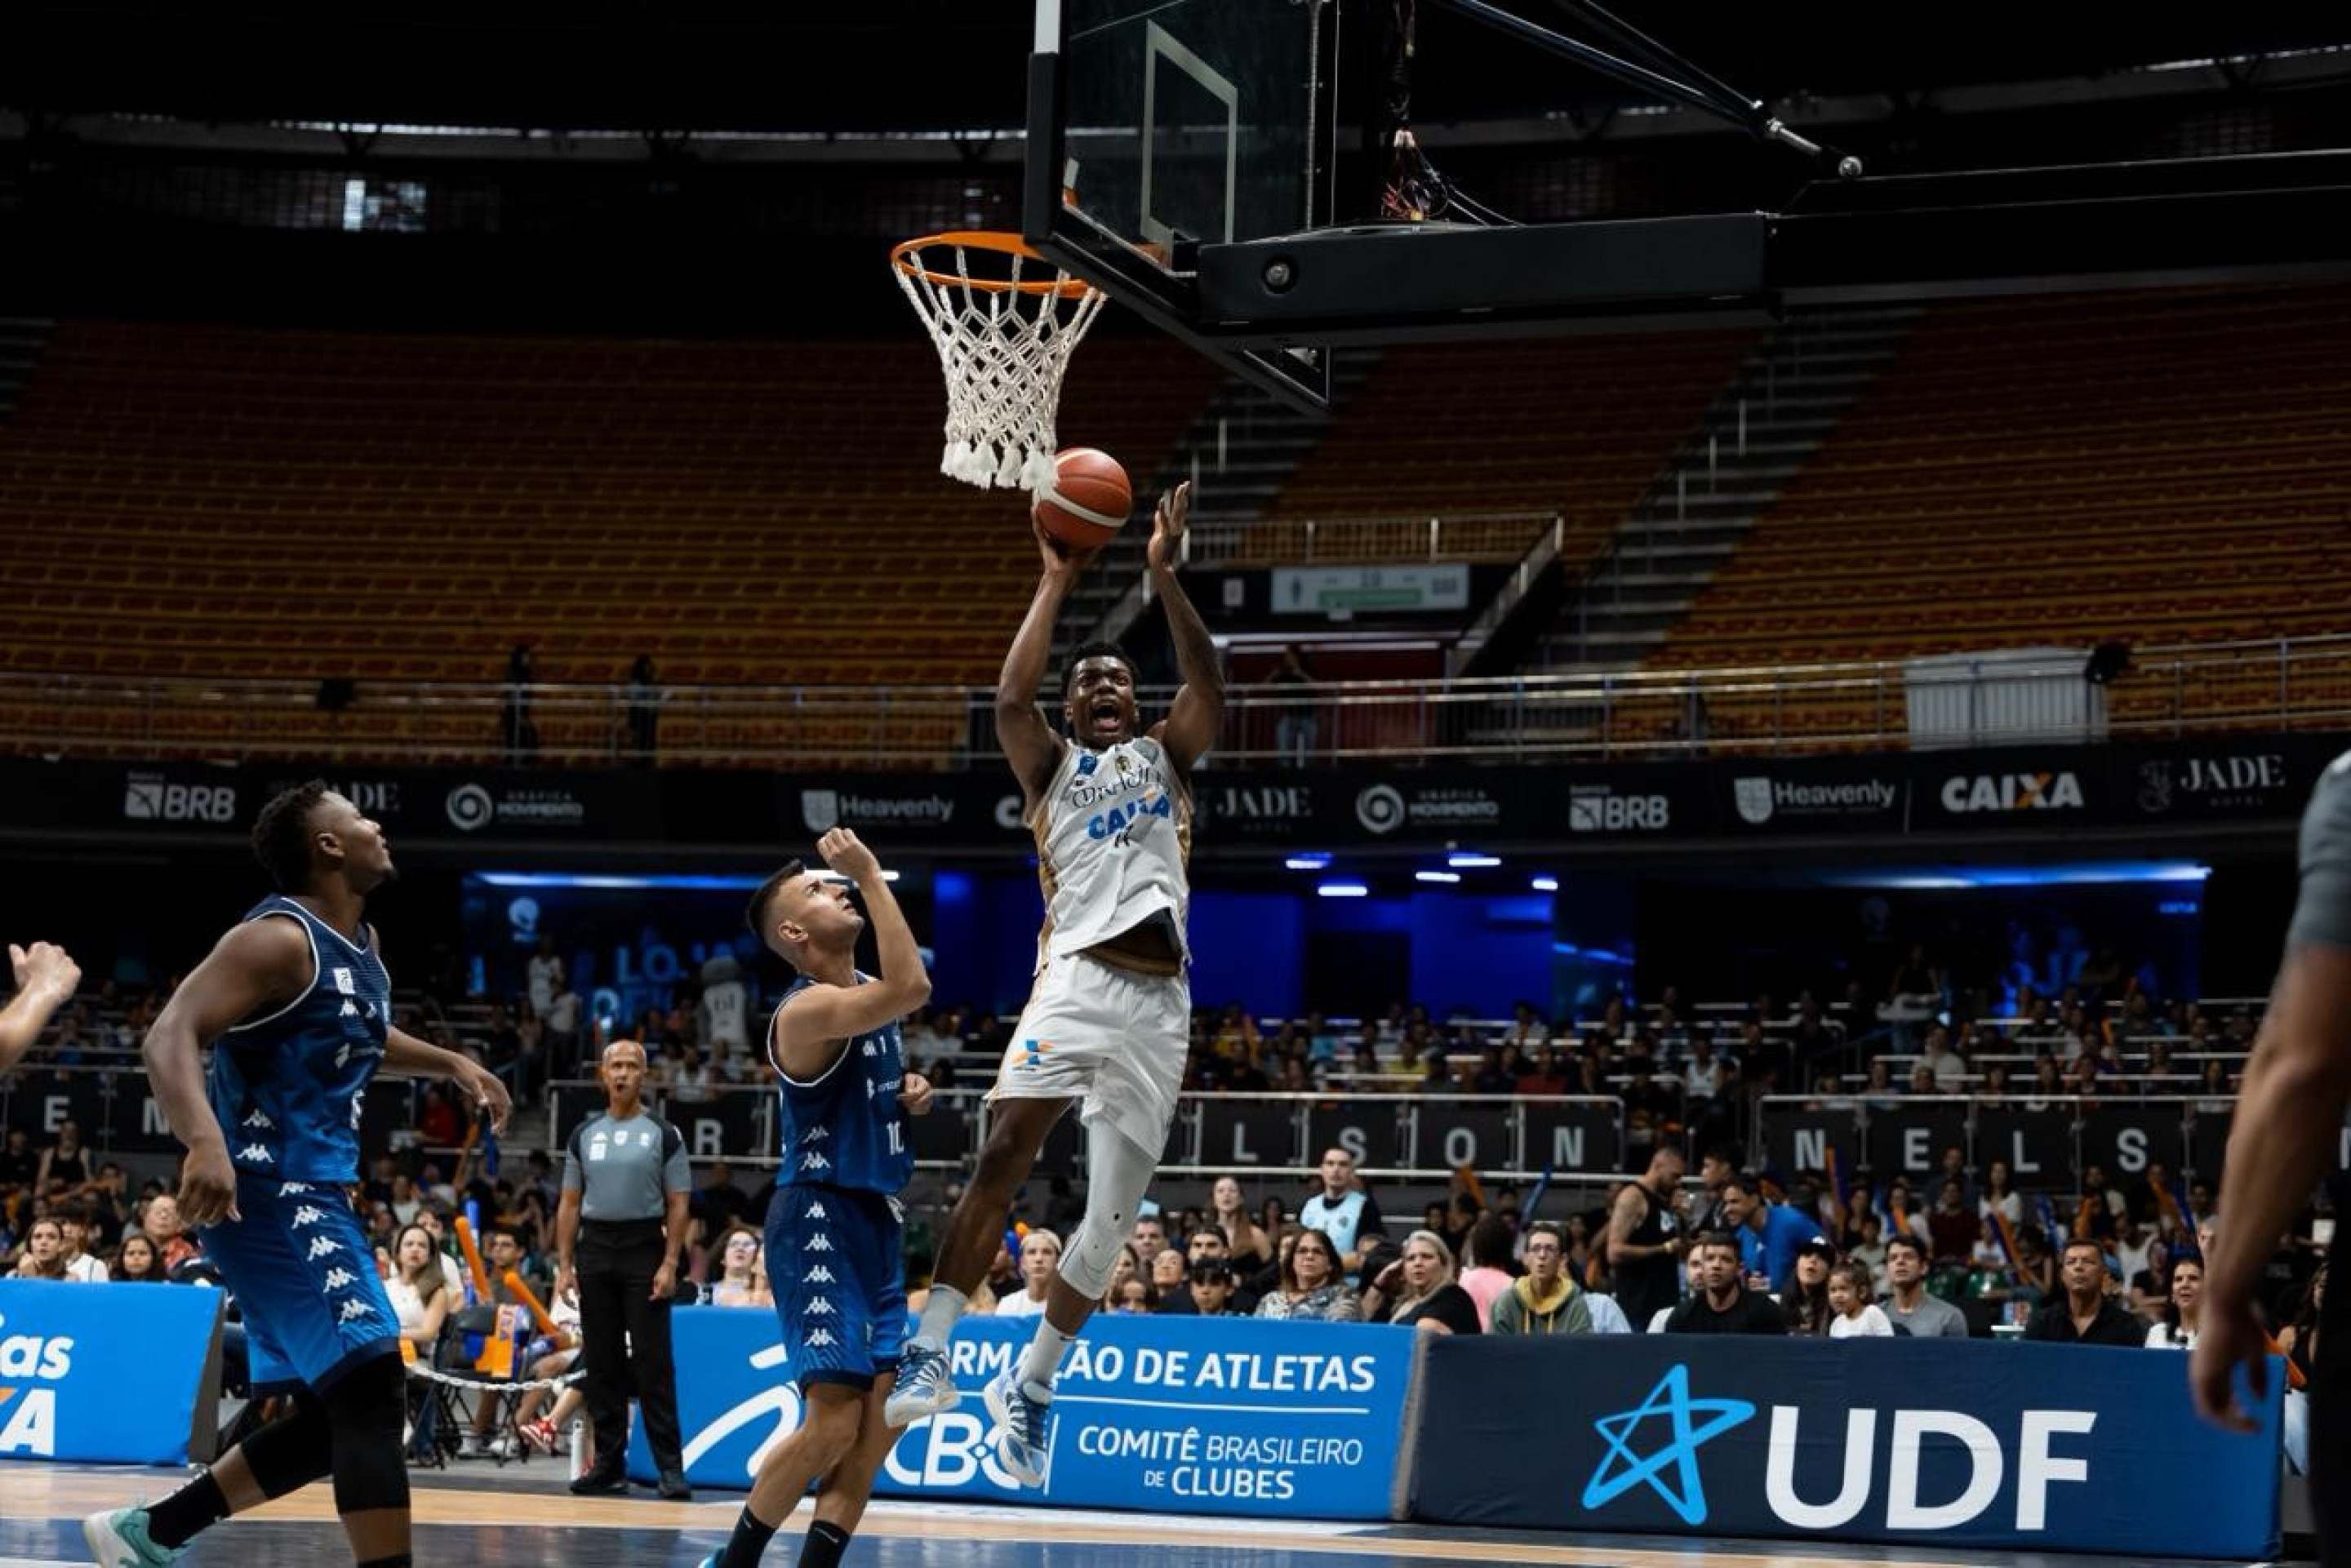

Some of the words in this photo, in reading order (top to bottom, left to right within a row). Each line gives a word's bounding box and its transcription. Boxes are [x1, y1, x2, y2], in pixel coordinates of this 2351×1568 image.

[2180, 754, 2287, 792] JADE
[163, 784, 235, 821] BRB
[839, 794, 954, 823] Heavenly
[1215, 787, 1313, 817] JADE
[1774, 778, 1895, 809] Heavenly
[1940, 772, 2085, 814] CAIXA
[1604, 795, 1670, 829] BRB
[1134, 1348, 1189, 1385] DE
[1195, 1353, 1376, 1392] ATLETAS
[1078, 1425, 1200, 1462] COMITÊ
[1206, 1434, 1363, 1466] BRASILEIRO
[1144, 1469, 1166, 1488] DE
[1171, 1465, 1295, 1499] CLUBES
[1764, 1405, 2098, 1530] UDF
